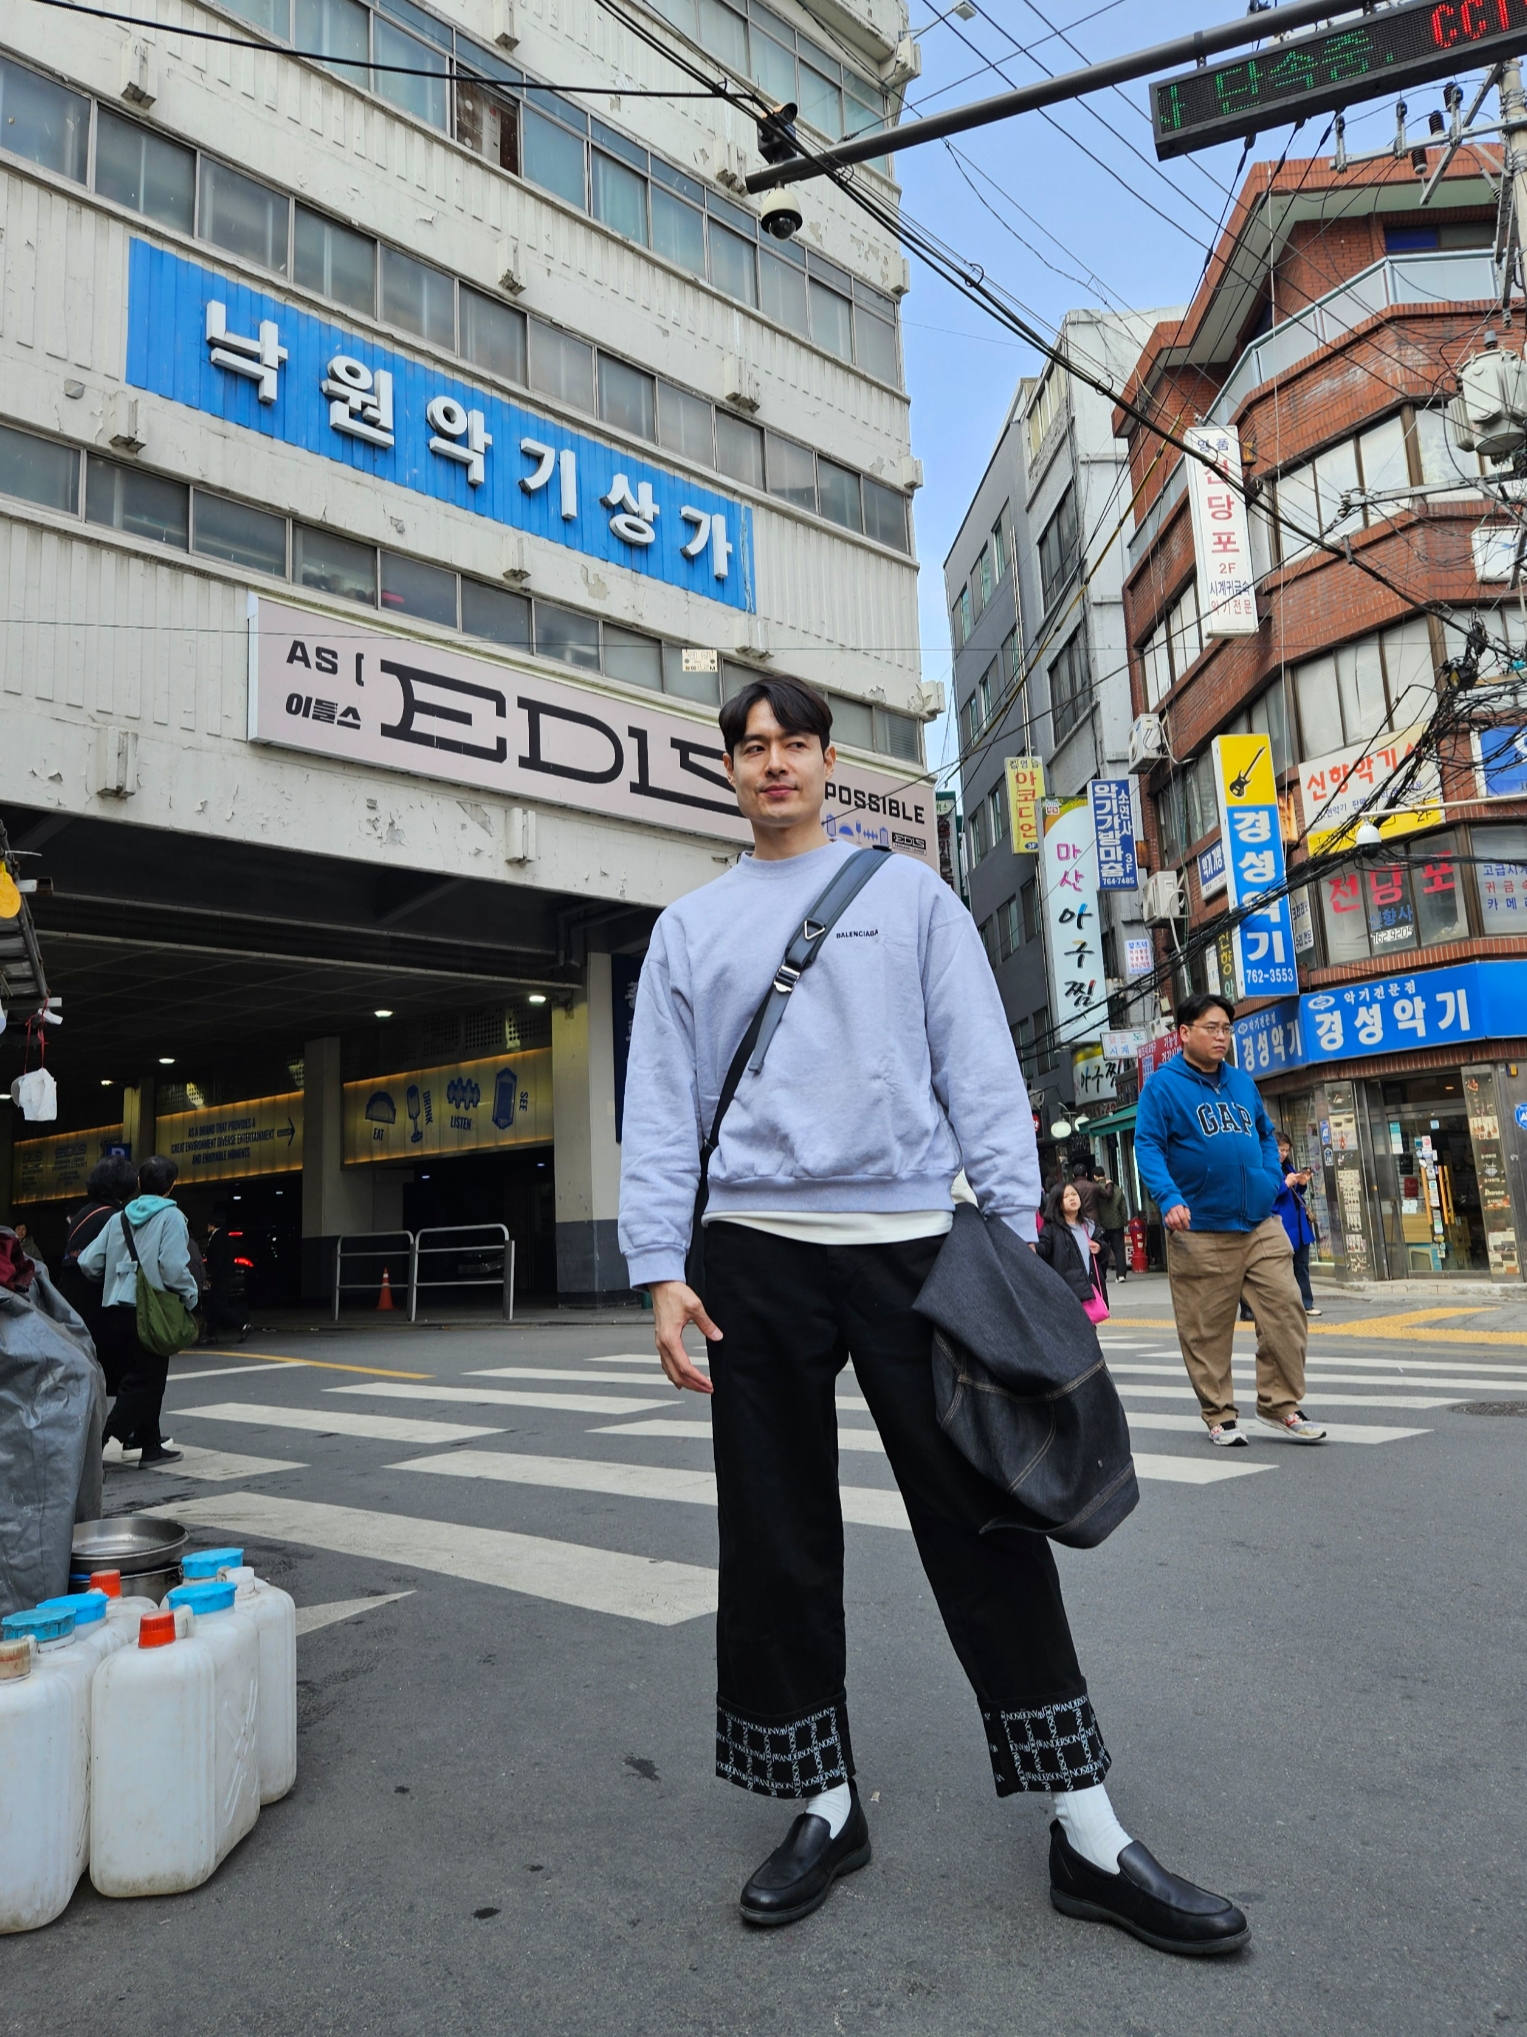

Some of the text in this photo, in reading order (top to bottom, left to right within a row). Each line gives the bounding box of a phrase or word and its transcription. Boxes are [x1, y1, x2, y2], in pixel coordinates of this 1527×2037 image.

[1219, 562, 1236, 574] 2F
[286, 640, 338, 675] AS
[825, 782, 925, 825] POSSIBLE
[1102, 876, 1134, 885] 764-7485
[1233, 810, 1287, 964] 경성악기
[1487, 897, 1527, 911] 카메
[836, 929, 879, 939] BALENCIAGA
[1246, 968, 1294, 984] 762-3553
[1315, 989, 1471, 1051] 경성악기
[1242, 1019, 1302, 1072] 경성악기
[423, 1090, 433, 1125] DRINK
[519, 1091, 529, 1111] SEE
[451, 1115, 472, 1130] LISTEN
[1196, 1102, 1253, 1137] GAP
[373, 1128, 384, 1141] EAT
